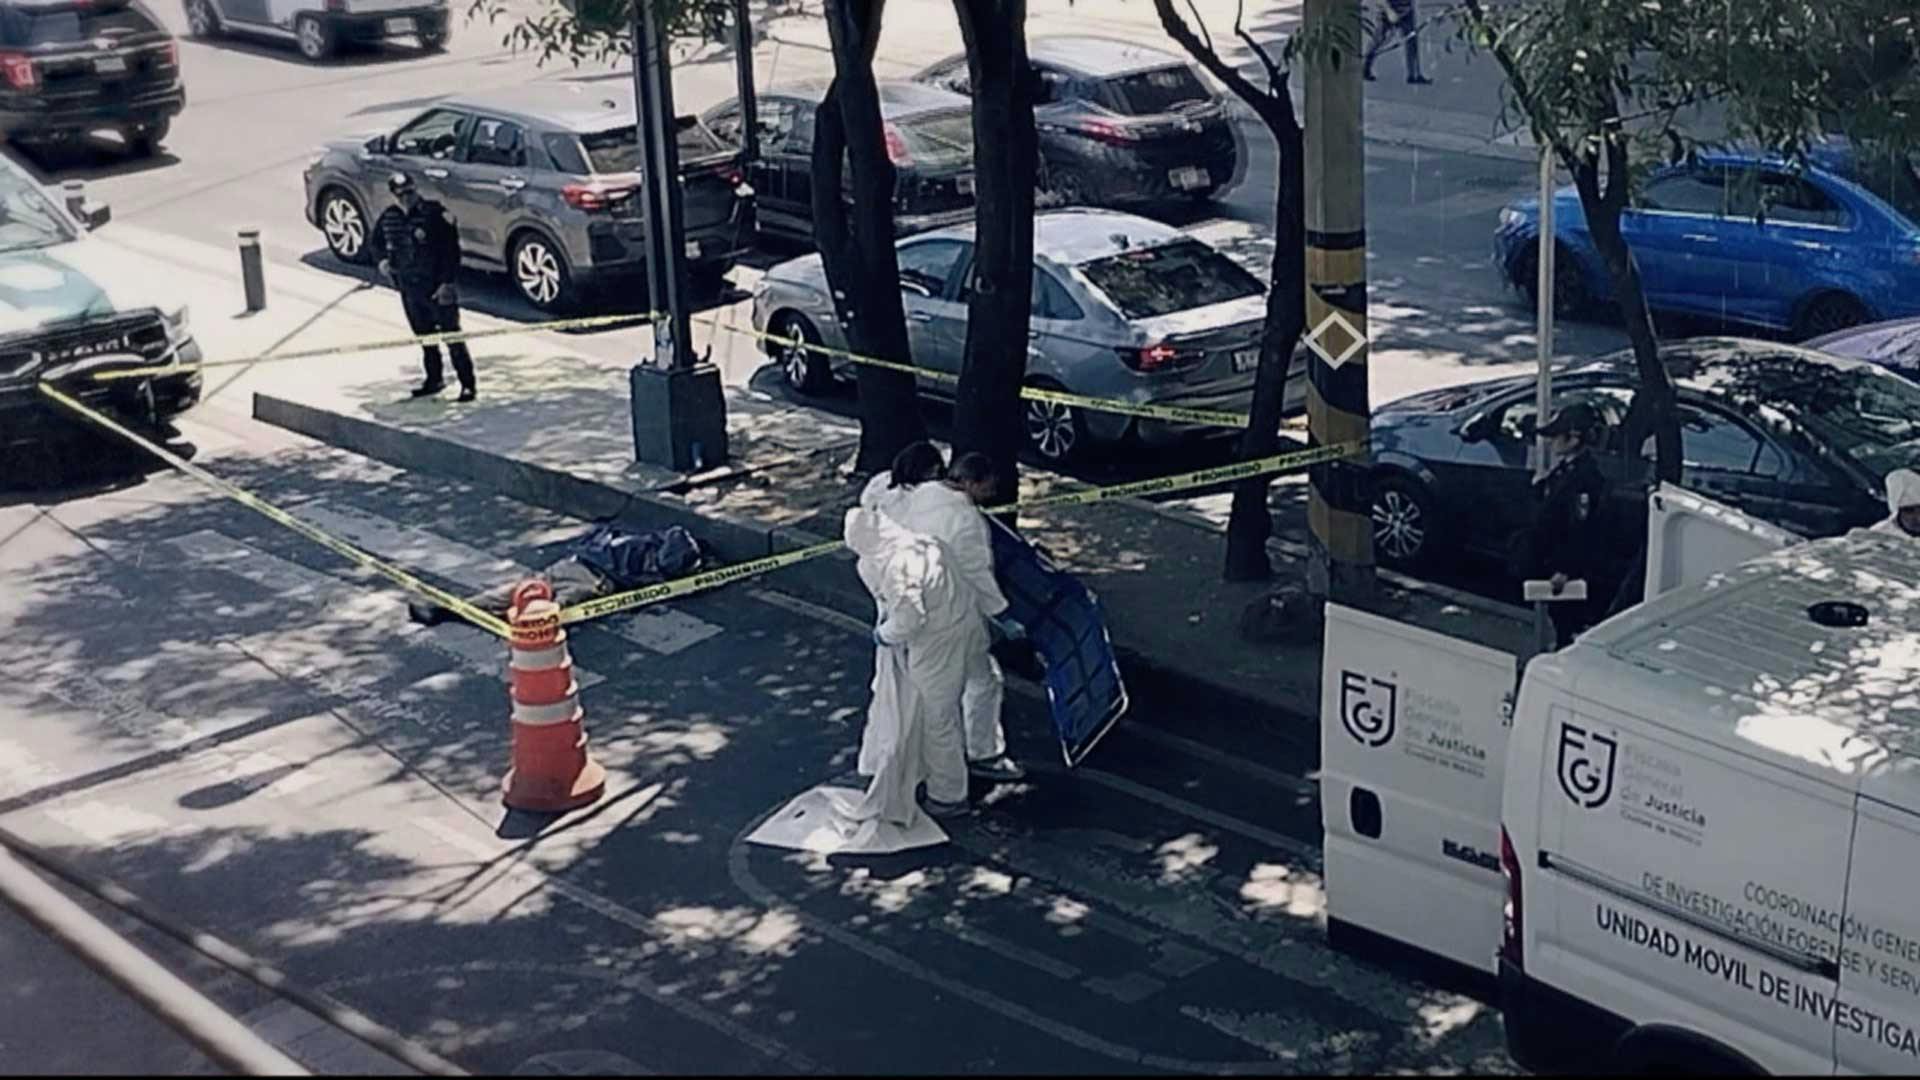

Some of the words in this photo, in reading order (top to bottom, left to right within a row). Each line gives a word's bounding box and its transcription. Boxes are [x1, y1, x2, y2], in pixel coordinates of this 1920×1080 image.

[1427, 731, 1487, 760] Justicia
[1644, 793, 1707, 828] Justicia
[1642, 872, 1663, 897] DE
[1665, 879, 1783, 942] INVESTIGACIÓN
[1865, 957, 1877, 975] Y
[1743, 880, 1868, 944] COORDINACIÓN
[1871, 928, 1920, 963] GENE
[1596, 904, 1680, 958] UNIDAD
[1684, 939, 1755, 990] MOVIL
[1759, 971, 1790, 1005] DE
[1794, 984, 1920, 1057] INVESTIGA
